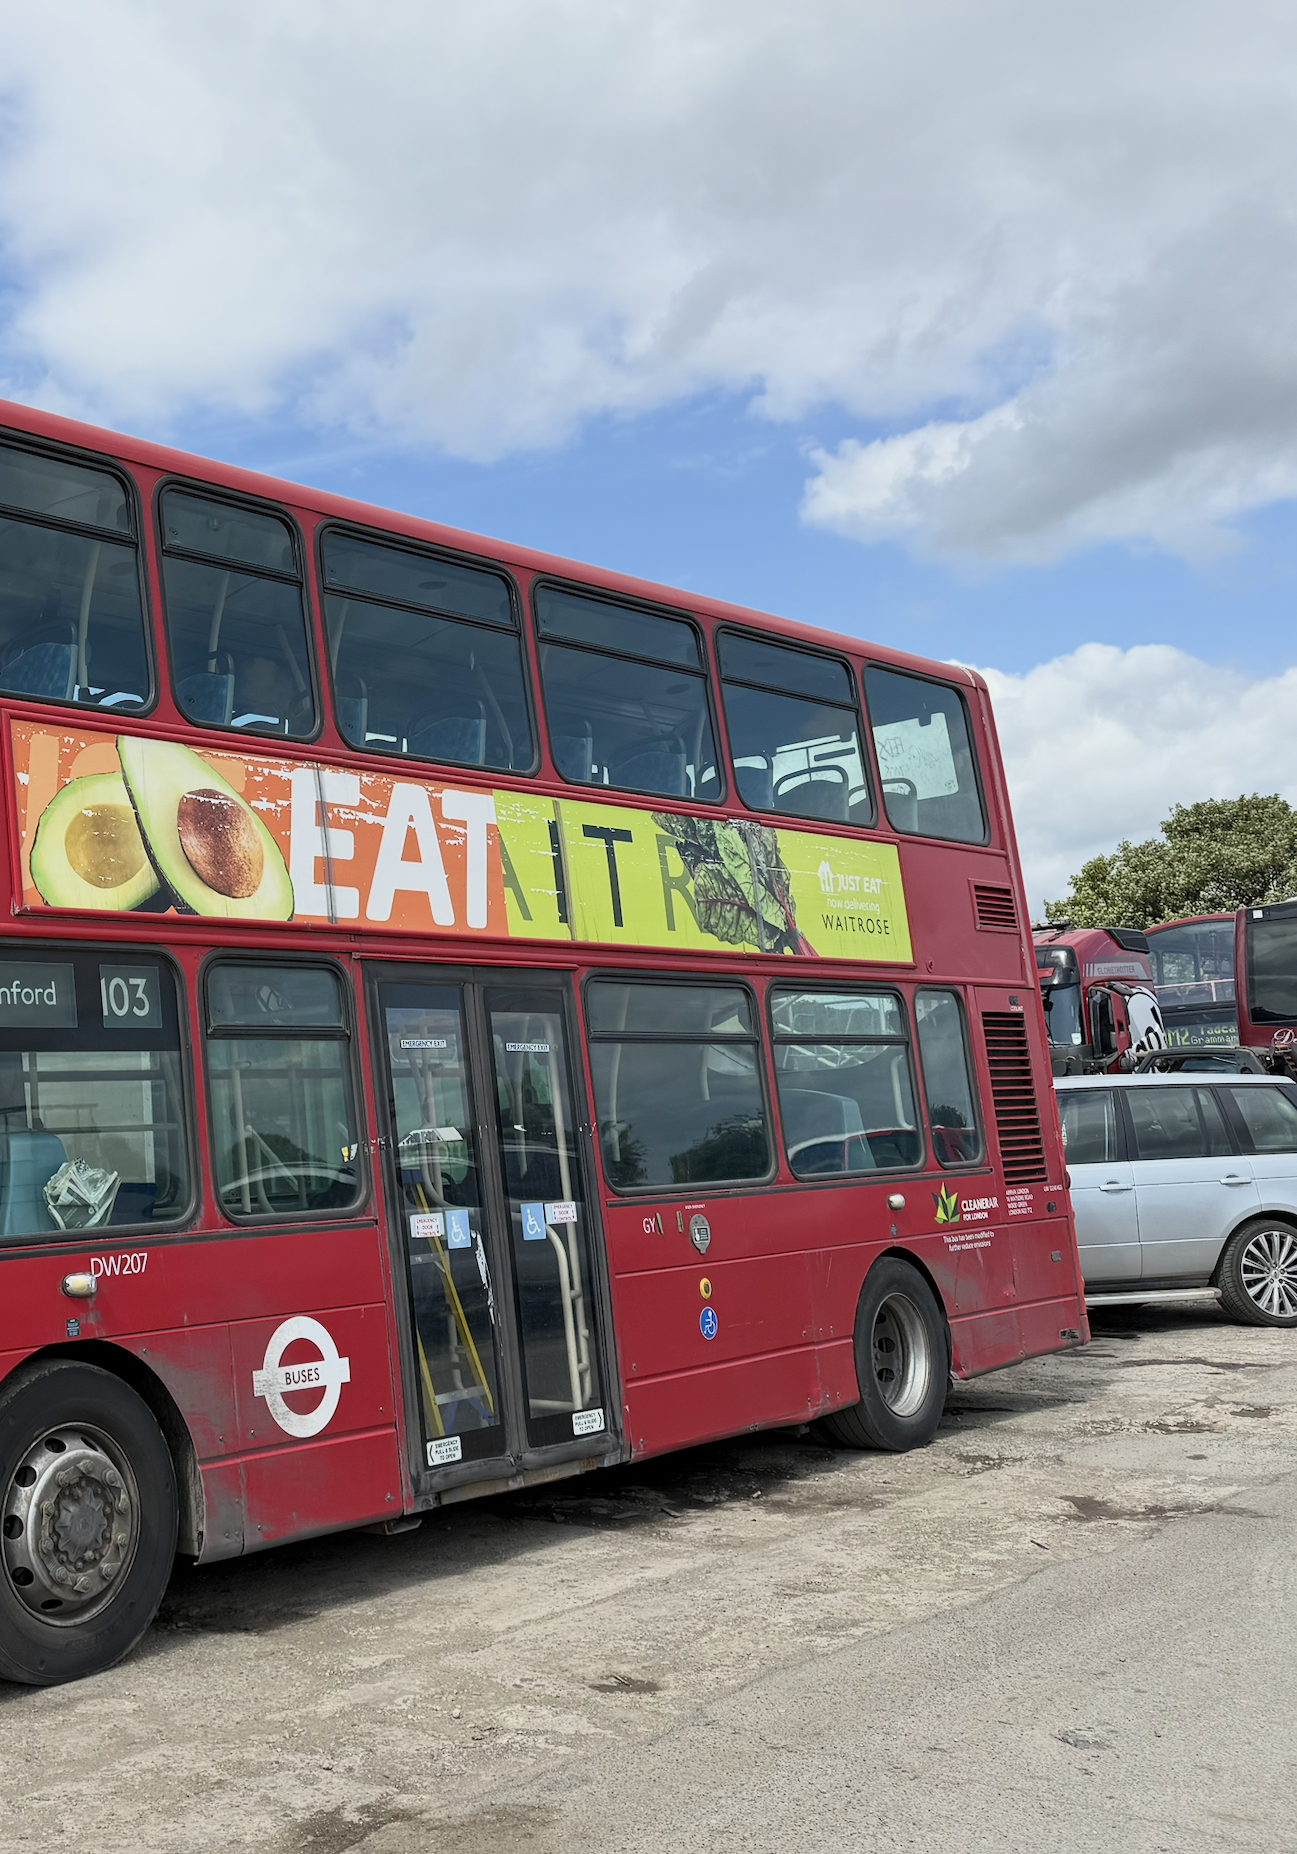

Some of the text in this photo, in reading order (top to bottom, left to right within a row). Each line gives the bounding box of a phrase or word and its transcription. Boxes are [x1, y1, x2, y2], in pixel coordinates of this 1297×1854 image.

[291, 768, 497, 929] EAT
[837, 874, 882, 894] JUST EAT
[827, 898, 880, 915] now delivering
[821, 914, 890, 935] WAITROSE
[1097, 965, 1136, 975] GLOBETROTTER
[100, 977, 150, 1017] 103
[1199, 1024, 1238, 1036] Tadca
[402, 1040, 445, 1048] EMERGENCY EXIT
[507, 1043, 537, 1051] EMERGENCY
[963, 1212, 989, 1221] FOR LONDON
[90, 1252, 148, 1278] DW207
[285, 1367, 320, 1386] BUSES
[574, 1412, 596, 1421] EMERGENCY
[435, 1440, 458, 1449] EMERGENCY
